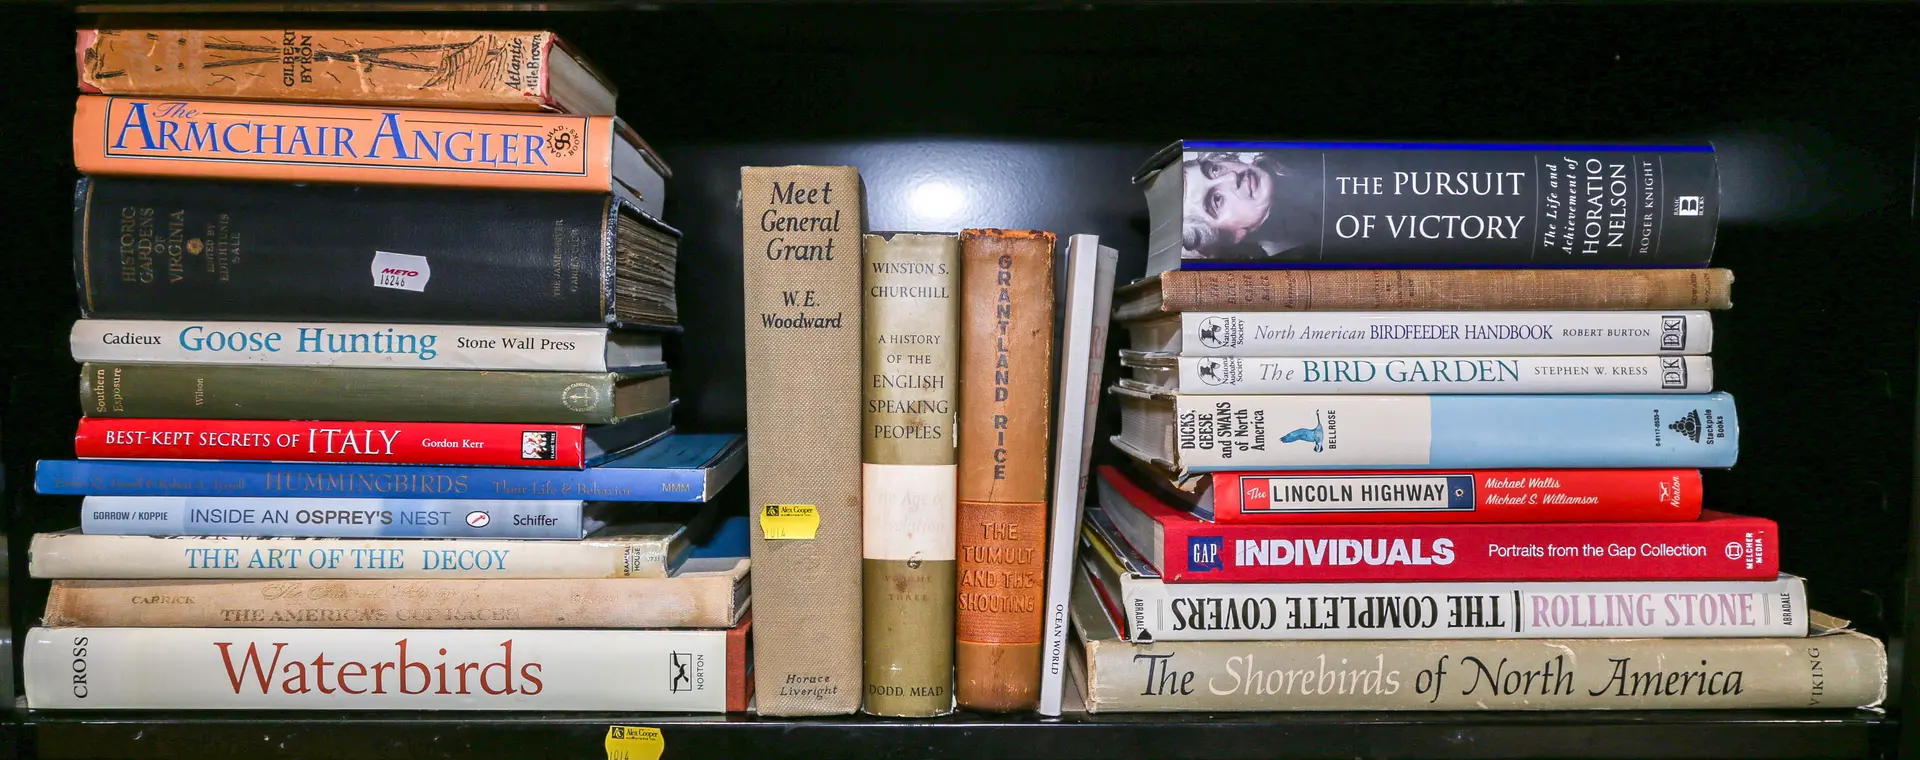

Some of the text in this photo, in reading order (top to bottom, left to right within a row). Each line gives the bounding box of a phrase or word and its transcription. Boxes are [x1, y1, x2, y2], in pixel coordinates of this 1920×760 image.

[282, 28, 296, 87] GILBERT
[300, 34, 312, 84] BYRON
[504, 36, 522, 92] Atlantic
[152, 102, 199, 119] The
[110, 102, 549, 168] ARMCHAIR ANGLER
[770, 182, 833, 205] Meet
[1336, 172, 1525, 196] THE PURSUIT
[1544, 164, 1560, 248] The Life and
[1562, 156, 1578, 255] Achievement of
[1582, 158, 1603, 254] HORATIO
[1607, 164, 1628, 248] NELSON
[1639, 160, 1654, 254] ROGER KNIGHT
[761, 210, 841, 232] General
[1336, 215, 1526, 240] OF VICTORY
[121, 205, 137, 283] HISTORIC
[138, 206, 154, 284] GARDENS
[154, 235, 166, 254] OF
[168, 208, 185, 284] VIRGINIA
[766, 237, 835, 262] Grant
[380, 274, 405, 287] 16246
[381, 268, 419, 277] METO
[872, 262, 950, 275] WINSTON S.
[871, 286, 950, 298] CHURCHILL
[761, 312, 842, 329] Woodward
[1254, 324, 1650, 340] North American BIRDFEEDER HANDBOOK ROBERT BURTON
[103, 326, 576, 361] Cadieux Goose Hunting Stone Wall Press
[878, 334, 940, 344] A HISTORY
[887, 354, 932, 364] OF THE
[994, 255, 1012, 480] GRANTLAND RICE
[1259, 360, 1648, 382] The BIRD GARDEN STEPHEN W. KRESS
[94, 369, 106, 413] Southern
[113, 368, 124, 412] Exposure
[195, 378, 204, 406] Wilson
[873, 374, 944, 389] ENGLISH
[868, 400, 948, 414] SPEAKING
[874, 426, 942, 440] PEOPLES
[1180, 410, 1196, 450] DUCKS,
[1198, 414, 1214, 450] GEESE
[1216, 402, 1232, 458] and SWANS
[1234, 408, 1248, 452] of North
[1250, 410, 1265, 452] America
[1328, 410, 1336, 450] BELLROSE
[1704, 410, 1714, 445] Stackpole
[1716, 416, 1724, 438] Books
[106, 428, 485, 456] BEST-KEPT SECRETS OF ITALY Gordon Kerr
[265, 472, 632, 496] HUMMINGBIRDS Their Life & Behavior
[1247, 484, 1445, 502] The LINCOLN HIGHWAY
[1485, 478, 1560, 489] Michael Wallis
[1670, 476, 1680, 508] Norton
[1486, 494, 1599, 506] Michael S. Williamson
[93, 508, 558, 527] GORROW KOPPIE INSIDE AN OSPREY'S NEST Schiffer
[980, 522, 1018, 540] THE
[185, 549, 510, 570] THE ART OF THE DECOY
[962, 546, 1035, 565] TUMULT
[1193, 544, 1218, 563] GAP
[1236, 538, 1455, 566] INDIVIDUALS
[1488, 543, 1707, 560] Portraits from the Gap Collection
[1746, 532, 1754, 570] MELCHER
[961, 569, 1034, 588] AND THE
[132, 594, 195, 605] CARRICK
[958, 592, 1035, 613] SHOUTING
[1172, 596, 1506, 631] THE COMPLETE COVERS
[1532, 593, 1756, 628] ROLLING STONE
[1780, 592, 1792, 626] ABRADALE
[220, 608, 265, 623] THE
[1134, 598, 1144, 631] ABRADALE
[1051, 604, 1064, 676] OCEAN WORLD
[73, 636, 89, 699] CROSS
[213, 638, 544, 695] Waterbirds
[696, 654, 705, 690] NORTON
[786, 674, 830, 684] Horace
[1133, 651, 1744, 704] The Shorebirds of North America
[1808, 647, 1824, 707] VIKING
[780, 686, 838, 700] Liveright
[910, 686, 944, 698] MEAD
